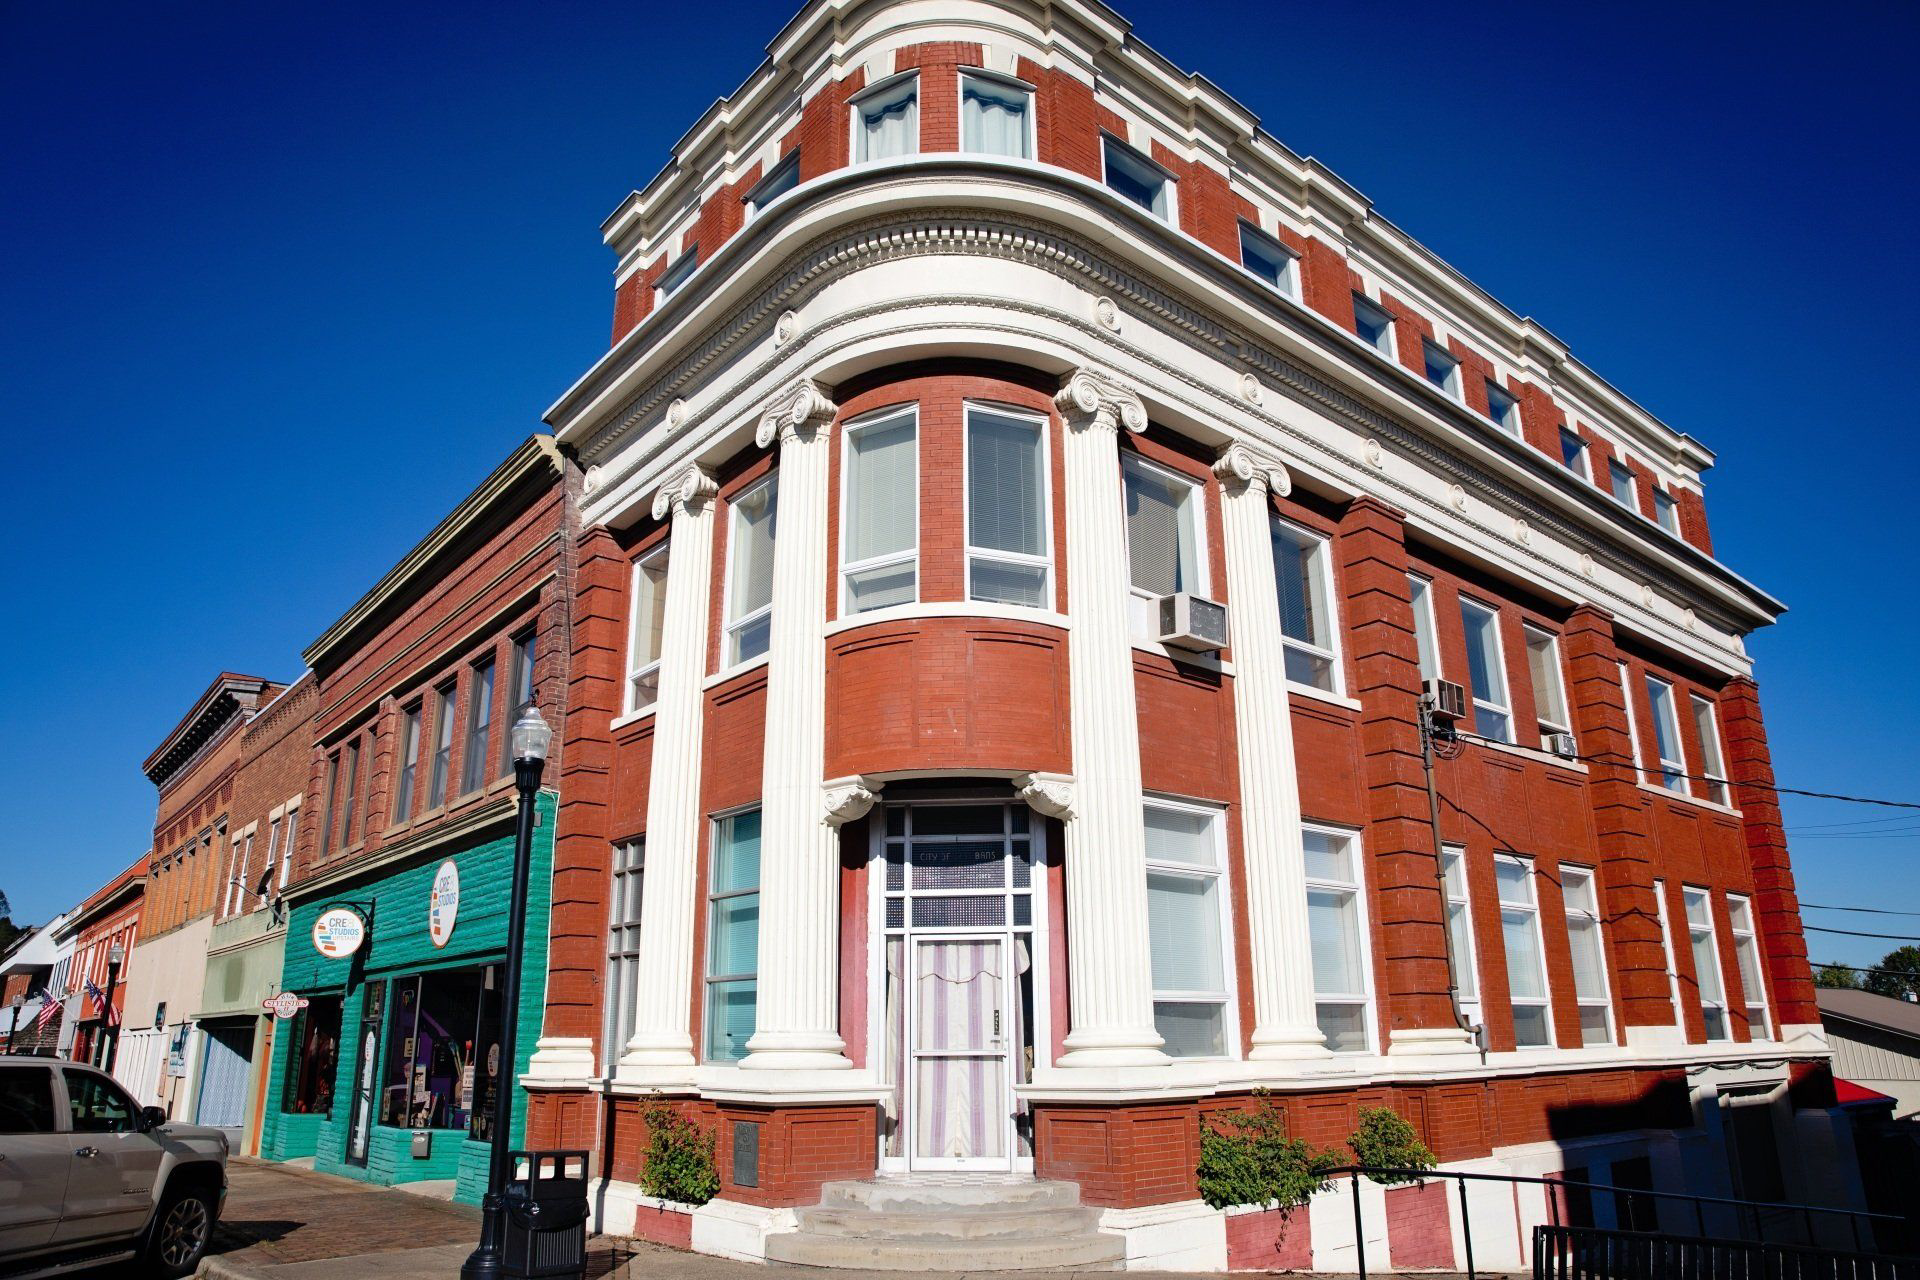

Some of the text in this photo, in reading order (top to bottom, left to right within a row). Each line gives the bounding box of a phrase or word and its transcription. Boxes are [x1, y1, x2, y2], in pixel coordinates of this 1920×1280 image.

[919, 852, 938, 861] CITY
[438, 892, 456, 907] STUDIOS
[329, 928, 360, 936] STUDIOS
